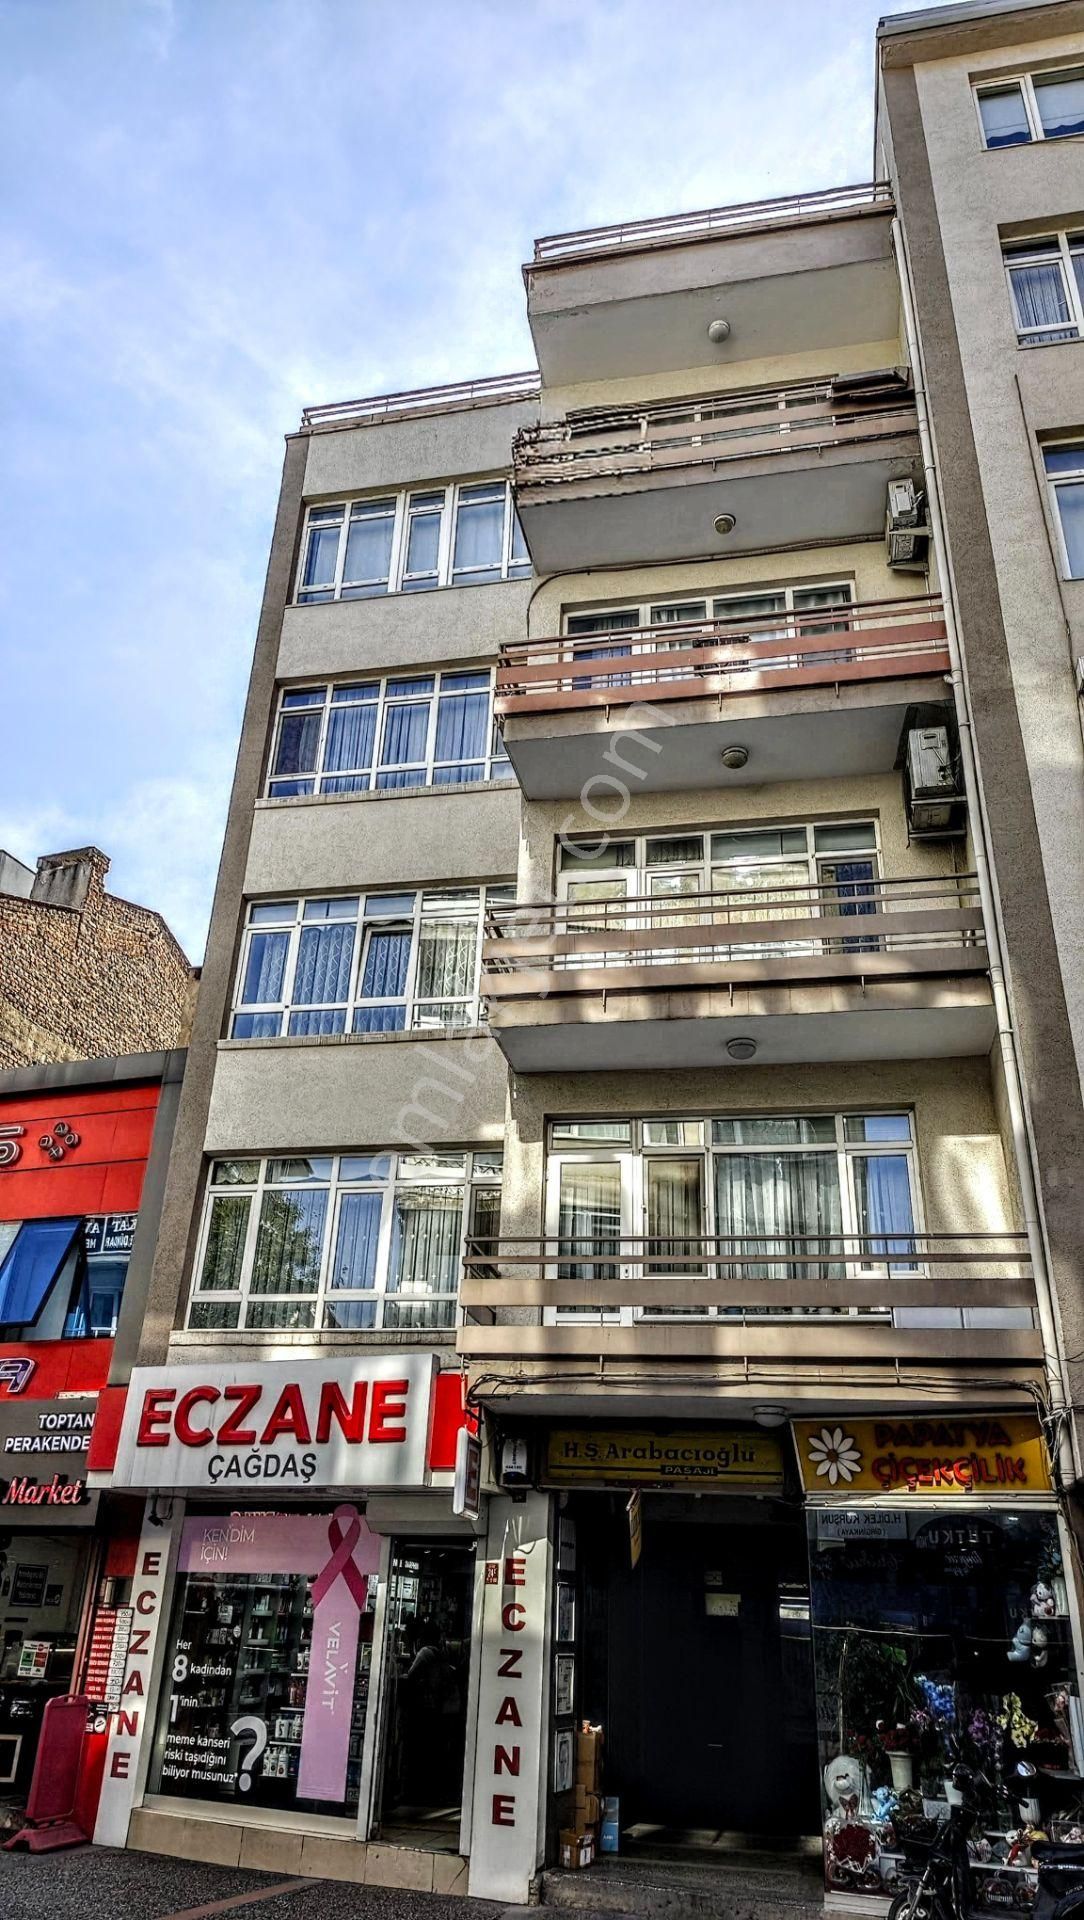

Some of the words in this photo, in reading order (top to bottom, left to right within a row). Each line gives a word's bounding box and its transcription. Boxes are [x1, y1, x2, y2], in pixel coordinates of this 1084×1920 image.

[38, 1413, 96, 1429] TOPTAN
[136, 1379, 409, 1447] ECZANE
[4, 1435, 91, 1452] PERAKENDE
[873, 1422, 1012, 1448] PAPATYA
[207, 1449, 317, 1484] ÇAĞDAŞ
[871, 1452, 1028, 1490] ÇİÇEKÇİLİK
[2, 1474, 82, 1505] Market
[200, 1544, 229, 1564] İÇİN!
[175, 1639, 192, 1650] Her
[108, 1552, 161, 1780] ECZANE
[172, 1654, 189, 1682] 8
[190, 1662, 232, 1676] kadından
[491, 1557, 527, 1827] ECZANE
[164, 1748, 183, 1761] riski
[166, 1734, 196, 1746] meme
[197, 1735, 231, 1749] kanseri
[162, 1765, 190, 1780] biliyor
